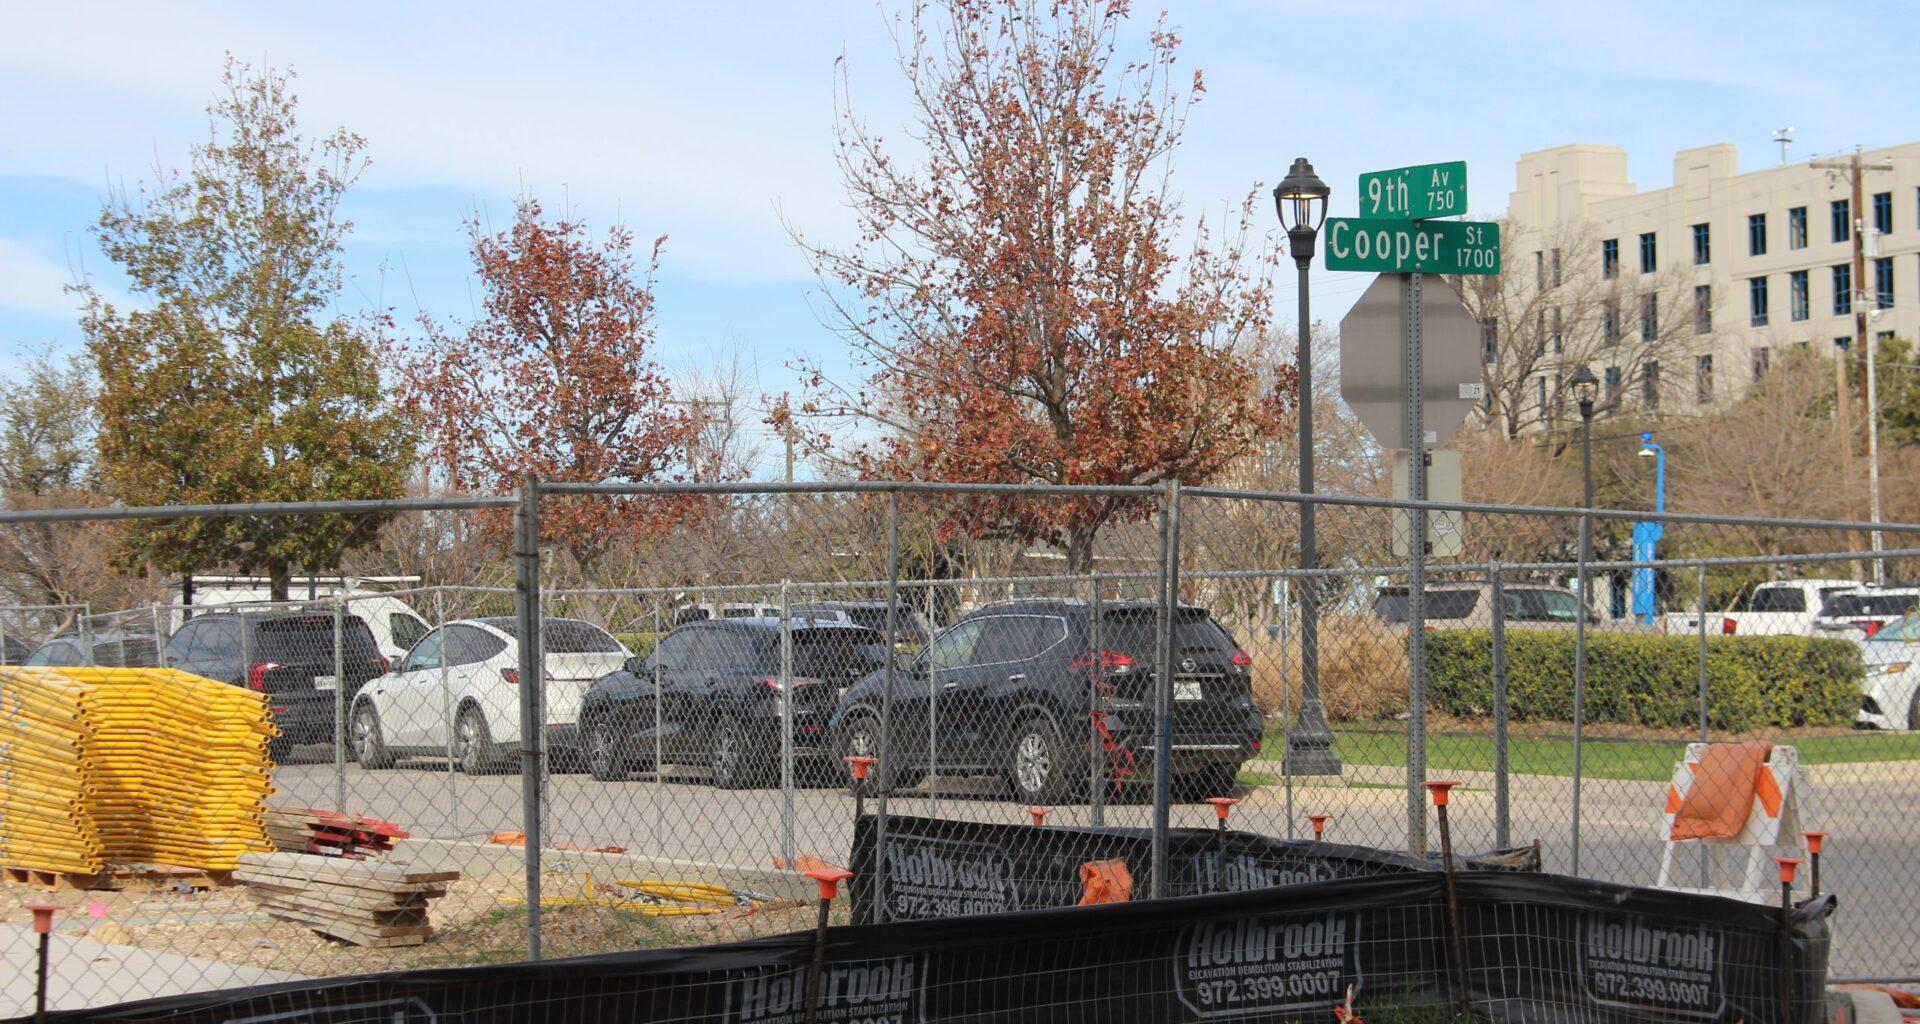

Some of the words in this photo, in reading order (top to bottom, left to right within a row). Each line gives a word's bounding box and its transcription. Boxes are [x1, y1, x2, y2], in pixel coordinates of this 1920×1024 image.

[1369, 175, 1409, 214] 9th
[1431, 168, 1449, 188] Av
[1427, 190, 1455, 211] 750
[1332, 221, 1444, 269] Cooper
[1466, 226, 1484, 245] St
[1457, 248, 1494, 268] 1700
[887, 841, 1006, 892] Holbrook
[1188, 911, 1346, 968] Holbrook
[1588, 912, 1714, 971] Holbrook
[1188, 966, 1236, 980] EXCAVATION
[1238, 962, 1286, 976] DEMOLITION
[1287, 957, 1344, 972] STABILIZATION
[1198, 970, 1341, 1005] 972.399.0007
[1595, 972, 1710, 1006] 972.399.0007
[848, 1001, 909, 1017] STABILIZATION
